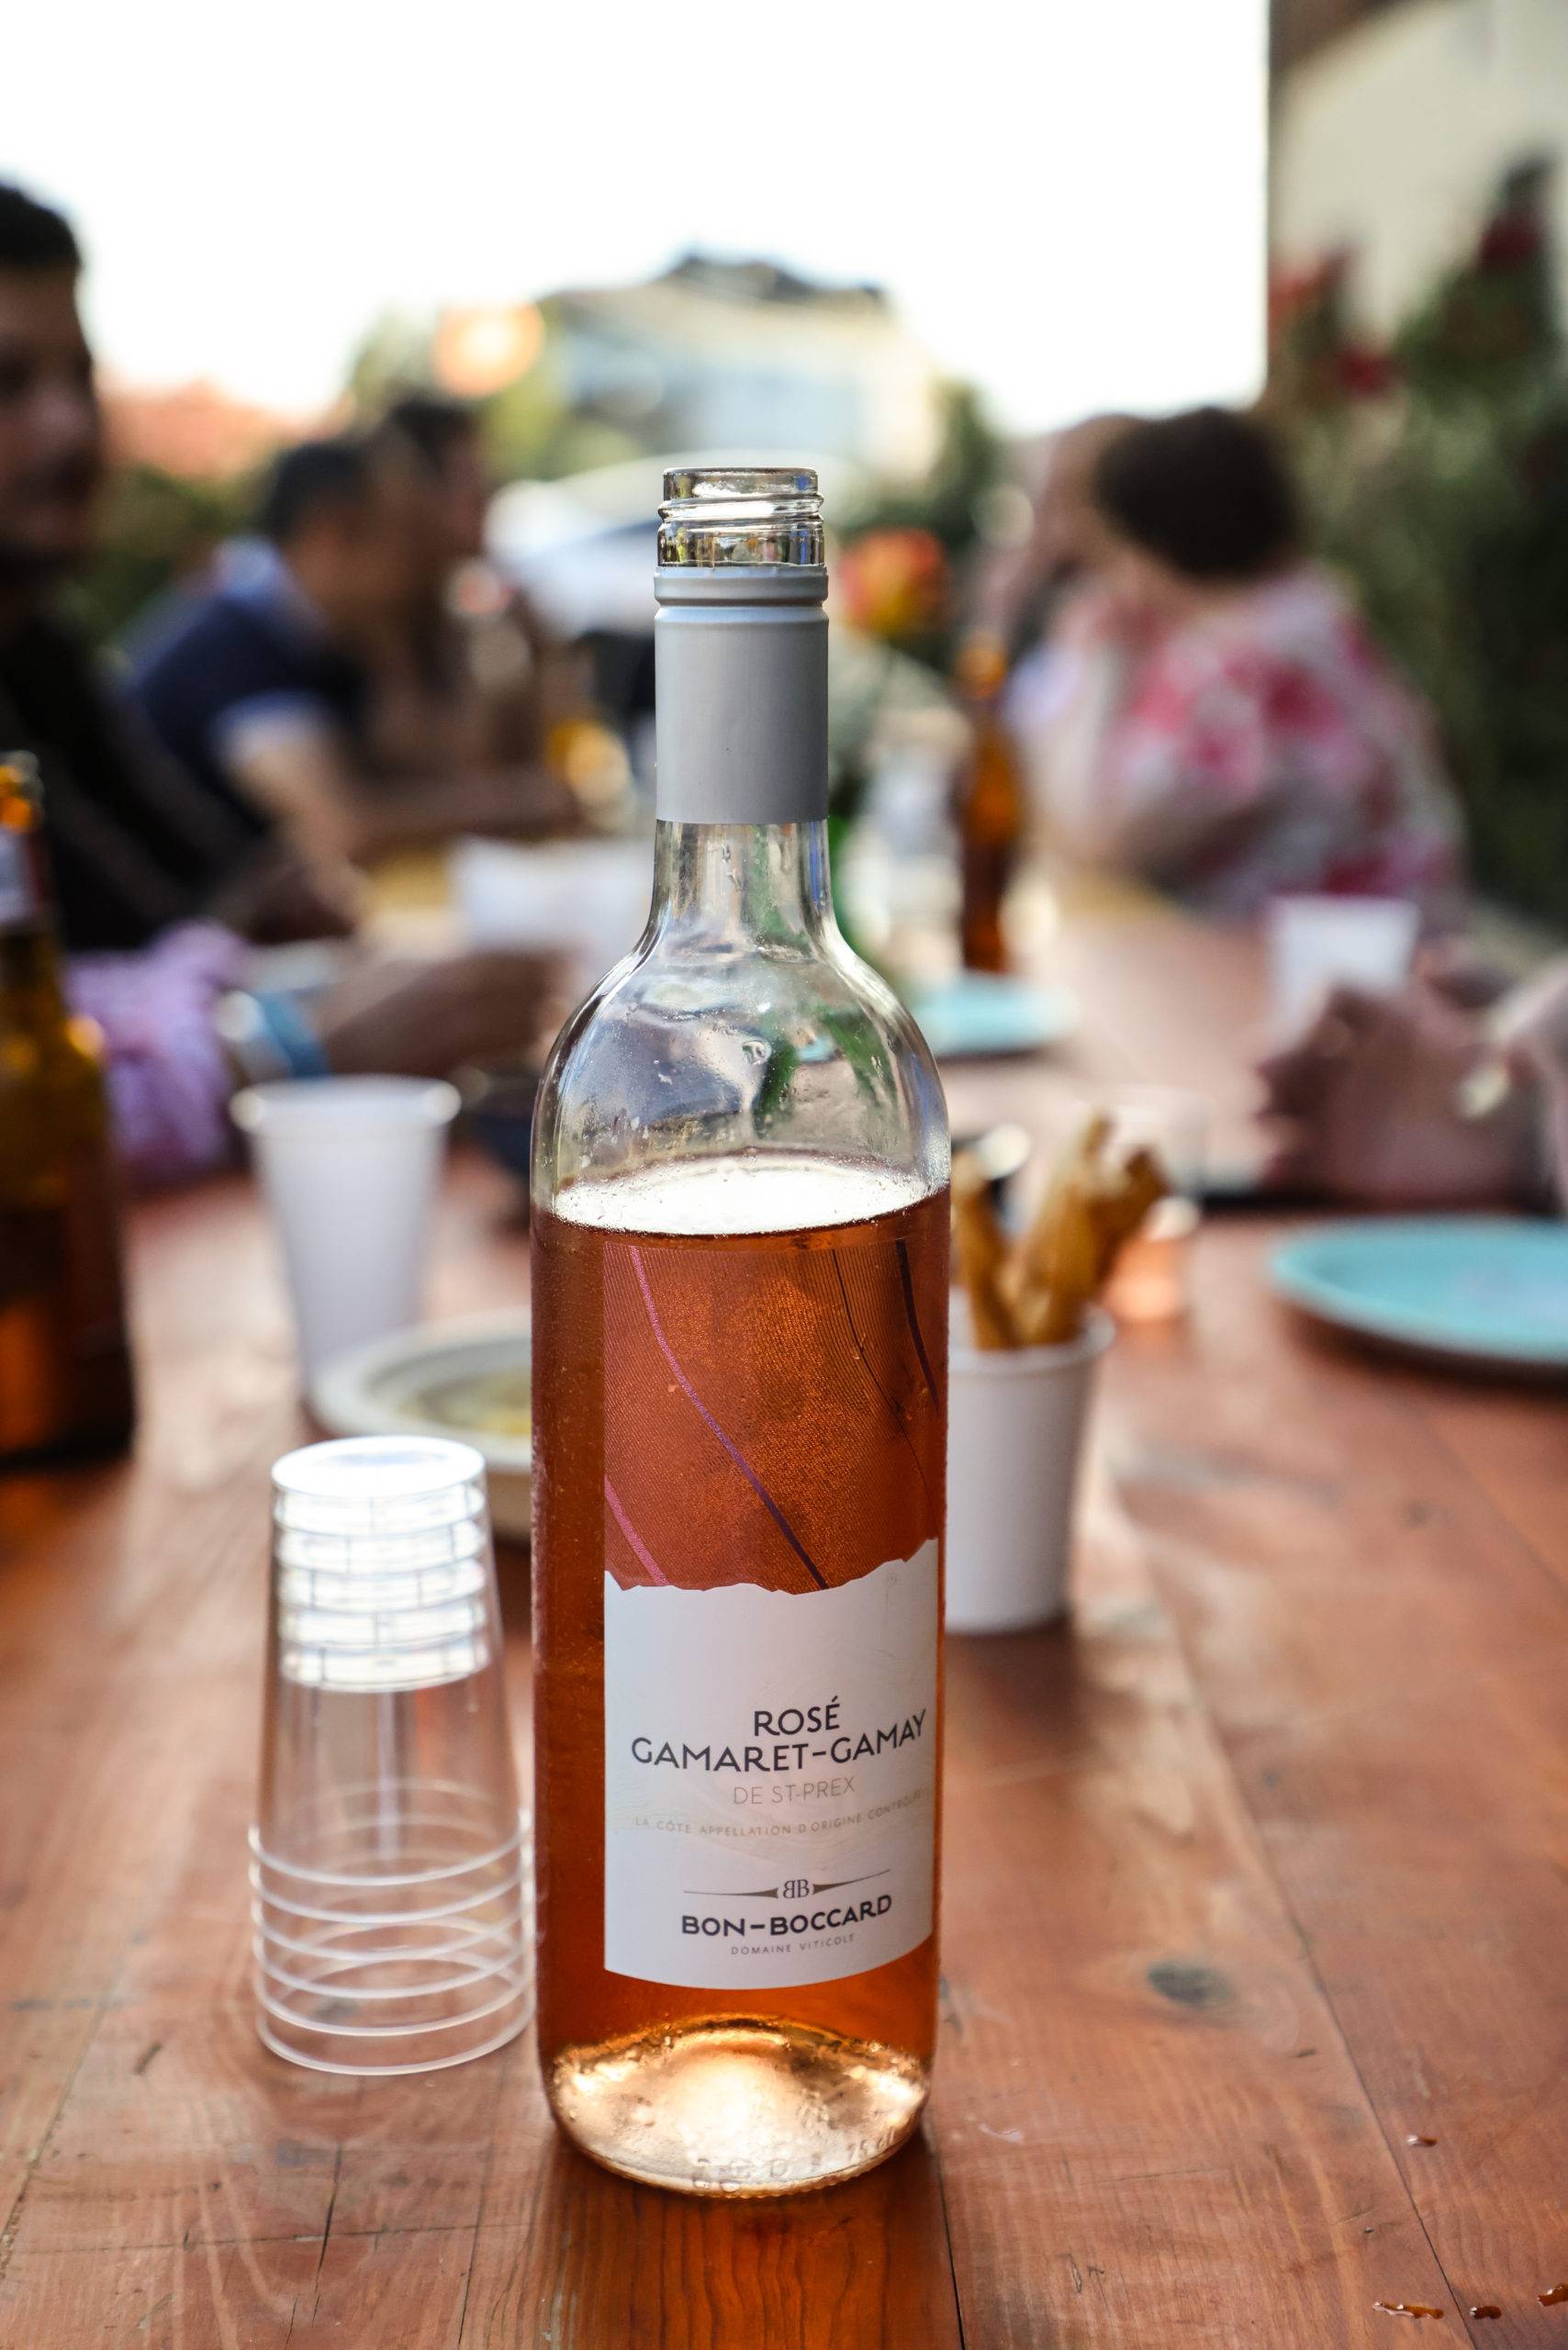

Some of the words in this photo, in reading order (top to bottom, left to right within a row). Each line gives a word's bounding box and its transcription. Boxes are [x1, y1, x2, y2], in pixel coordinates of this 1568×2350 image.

[754, 1695, 840, 1736] ROSÉ
[632, 1708, 927, 1773] GAMARET-GAMAY
[734, 1786, 763, 1805] DE
[771, 1776, 856, 1804] ST-PREX
[635, 1817, 649, 1827] LA
[656, 1819, 690, 1834] CÔTE
[700, 1824, 791, 1837] APPELLATION
[798, 1813, 862, 1833] D'ORIGINE
[681, 1894, 892, 1937] BON-BOCCARD
[731, 1943, 792, 1955] DOMAINE
[799, 1932, 856, 1951] VITICOLE
